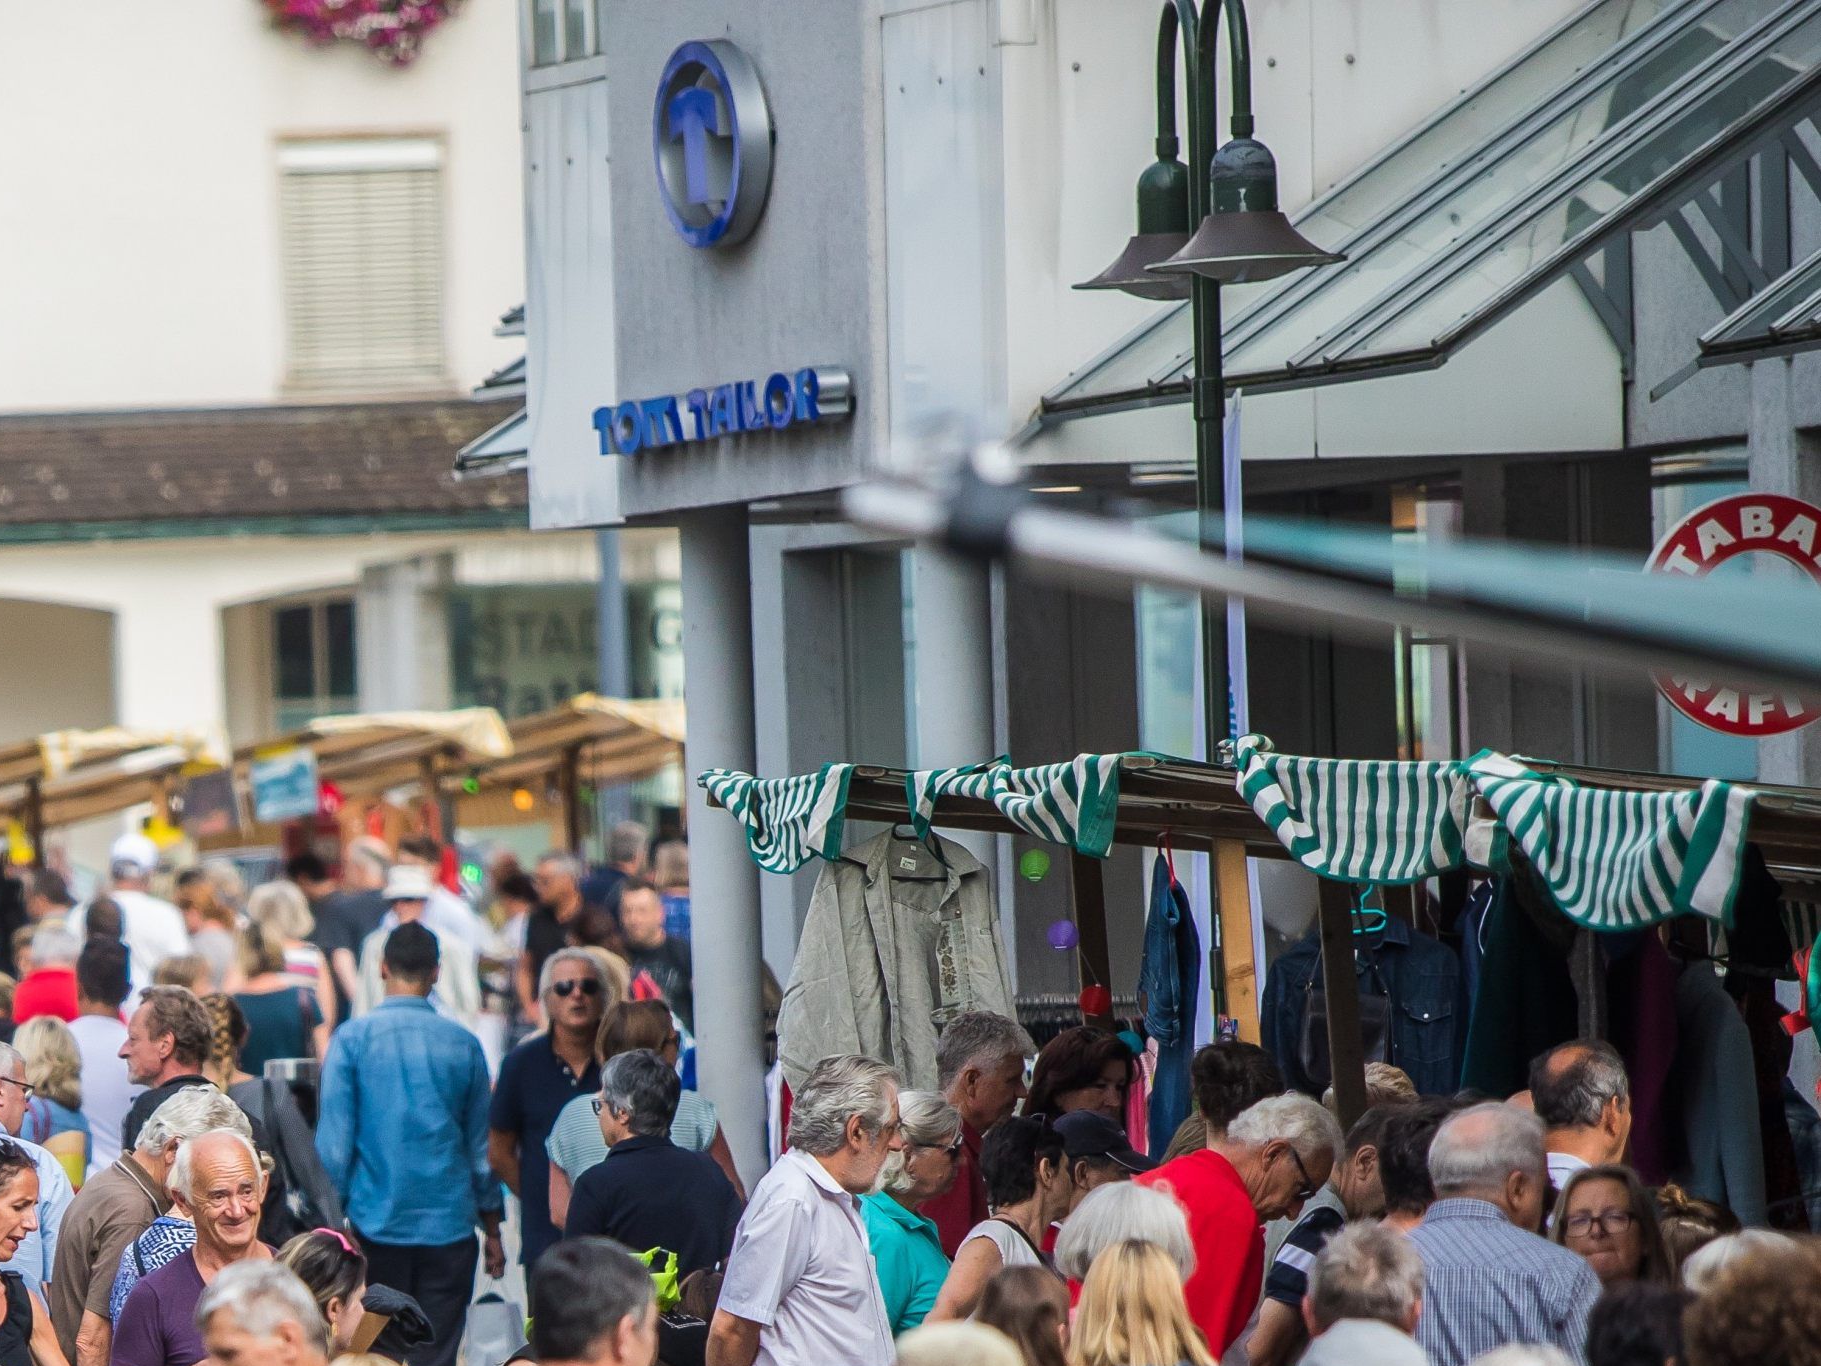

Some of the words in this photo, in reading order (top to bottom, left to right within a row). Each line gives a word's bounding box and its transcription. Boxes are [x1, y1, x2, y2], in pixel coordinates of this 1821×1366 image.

[592, 395, 684, 455] TOM
[687, 367, 820, 440] TAILOR
[1663, 504, 1821, 576] TABA
